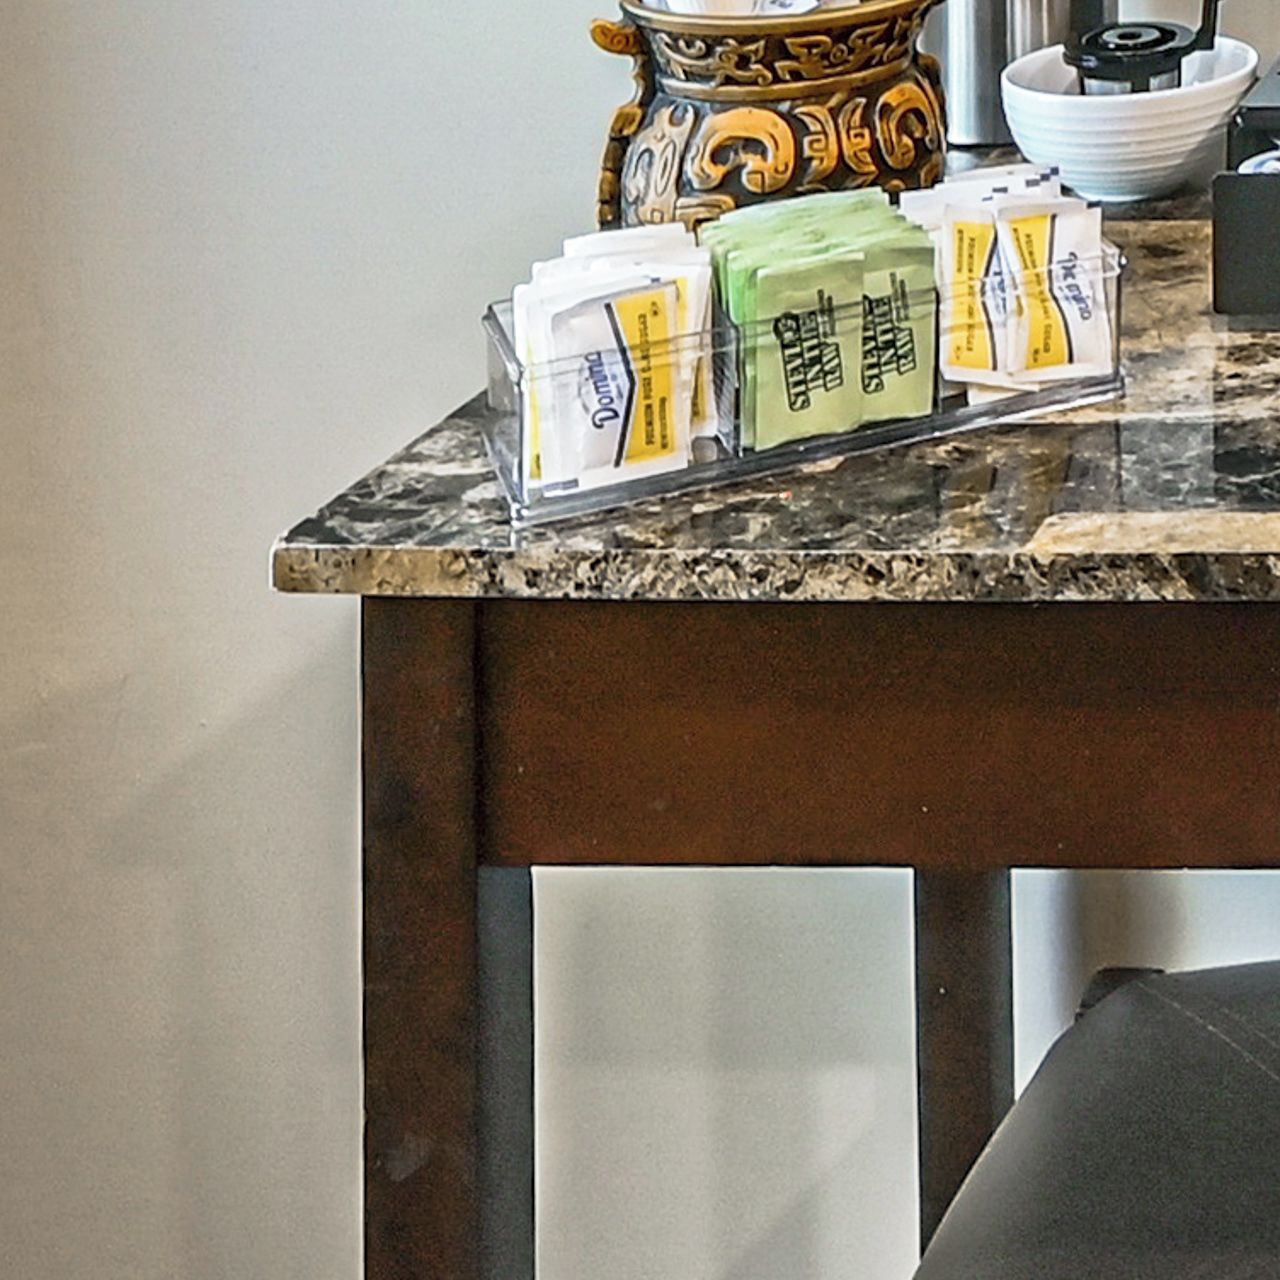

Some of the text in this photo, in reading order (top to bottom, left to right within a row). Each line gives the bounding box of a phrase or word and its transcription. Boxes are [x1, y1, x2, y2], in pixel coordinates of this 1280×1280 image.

[822, 343, 843, 390] RAW
[879, 347, 897, 373] IN
[896, 328, 916, 374] RAW
[584, 351, 620, 429] Domino
[805, 363, 826, 391] IN
